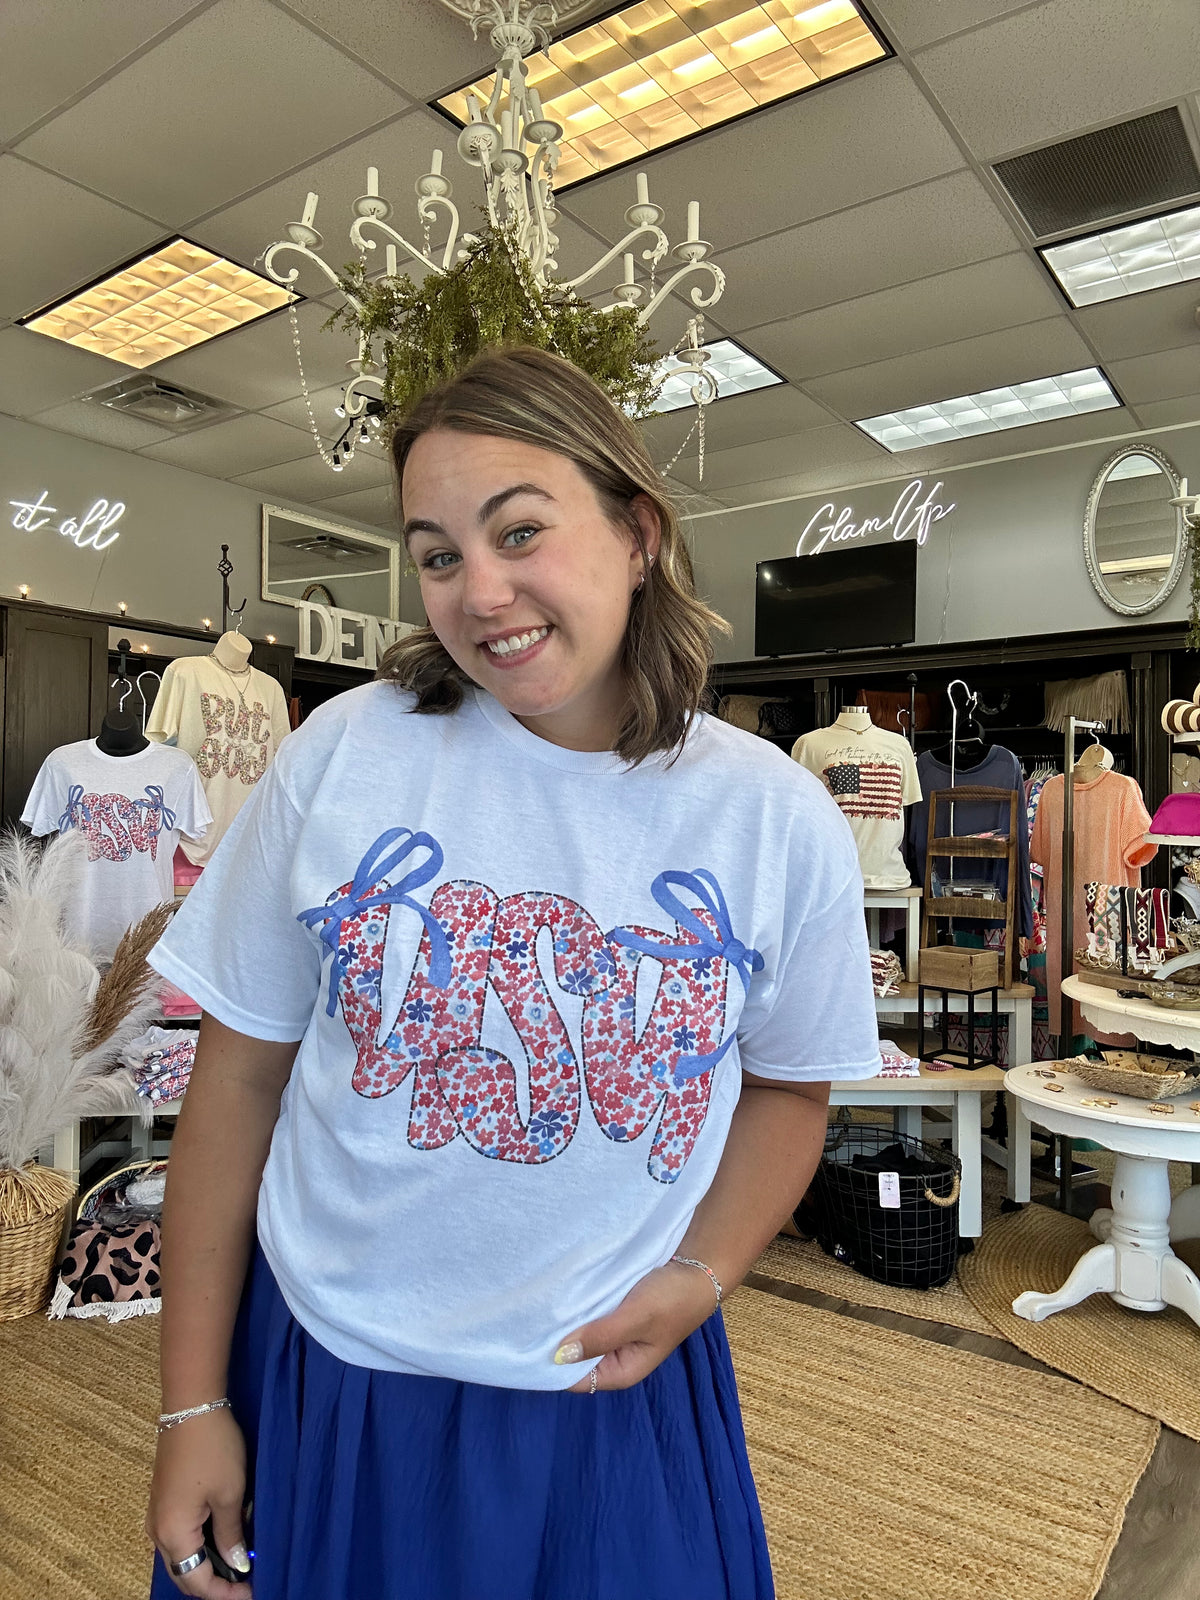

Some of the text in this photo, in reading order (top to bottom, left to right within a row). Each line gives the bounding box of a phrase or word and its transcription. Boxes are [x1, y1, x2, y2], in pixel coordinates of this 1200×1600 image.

[9, 490, 126, 550] it all
[795, 479, 956, 558] Glam Up
[294, 599, 428, 671] DEN
[324, 878, 730, 1185] USA
